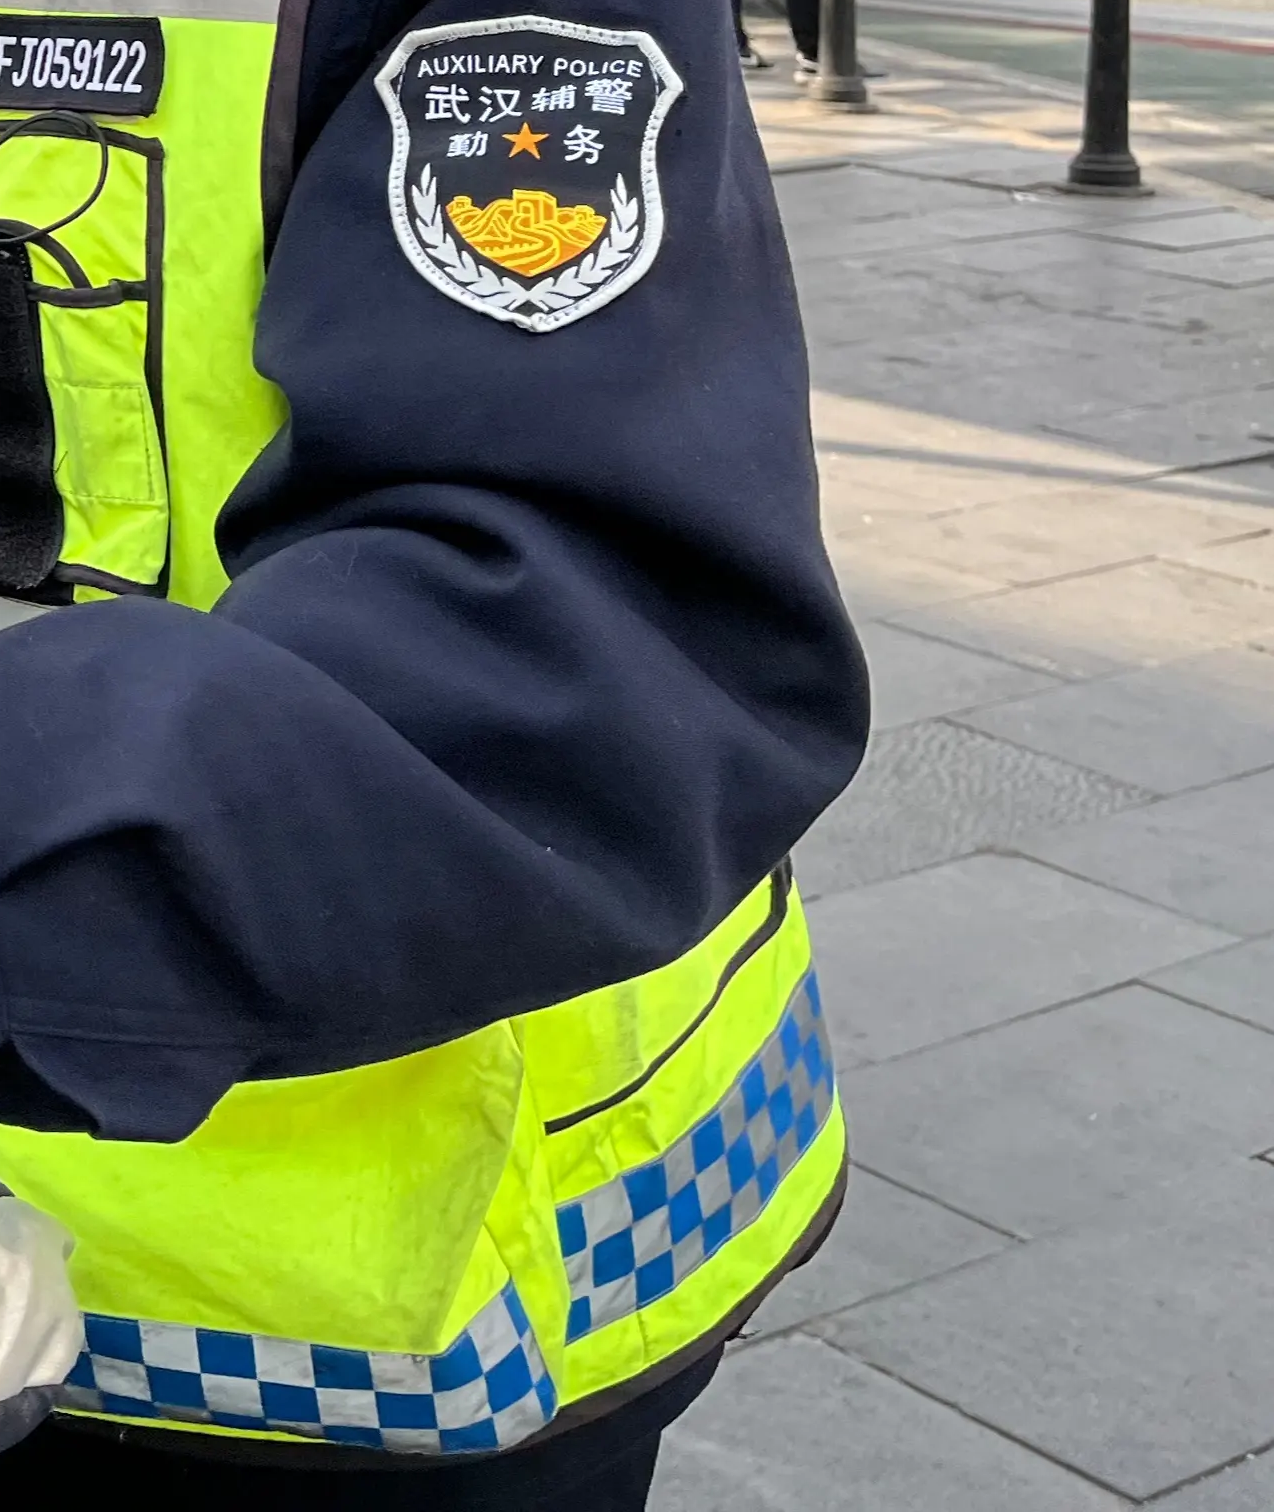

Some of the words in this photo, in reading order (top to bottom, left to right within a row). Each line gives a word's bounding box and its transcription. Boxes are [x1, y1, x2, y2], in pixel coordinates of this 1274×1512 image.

[417, 54, 544, 78] AUXILIARY
[553, 57, 644, 78] POLICE
[424, 77, 633, 124] 武汉辅警
